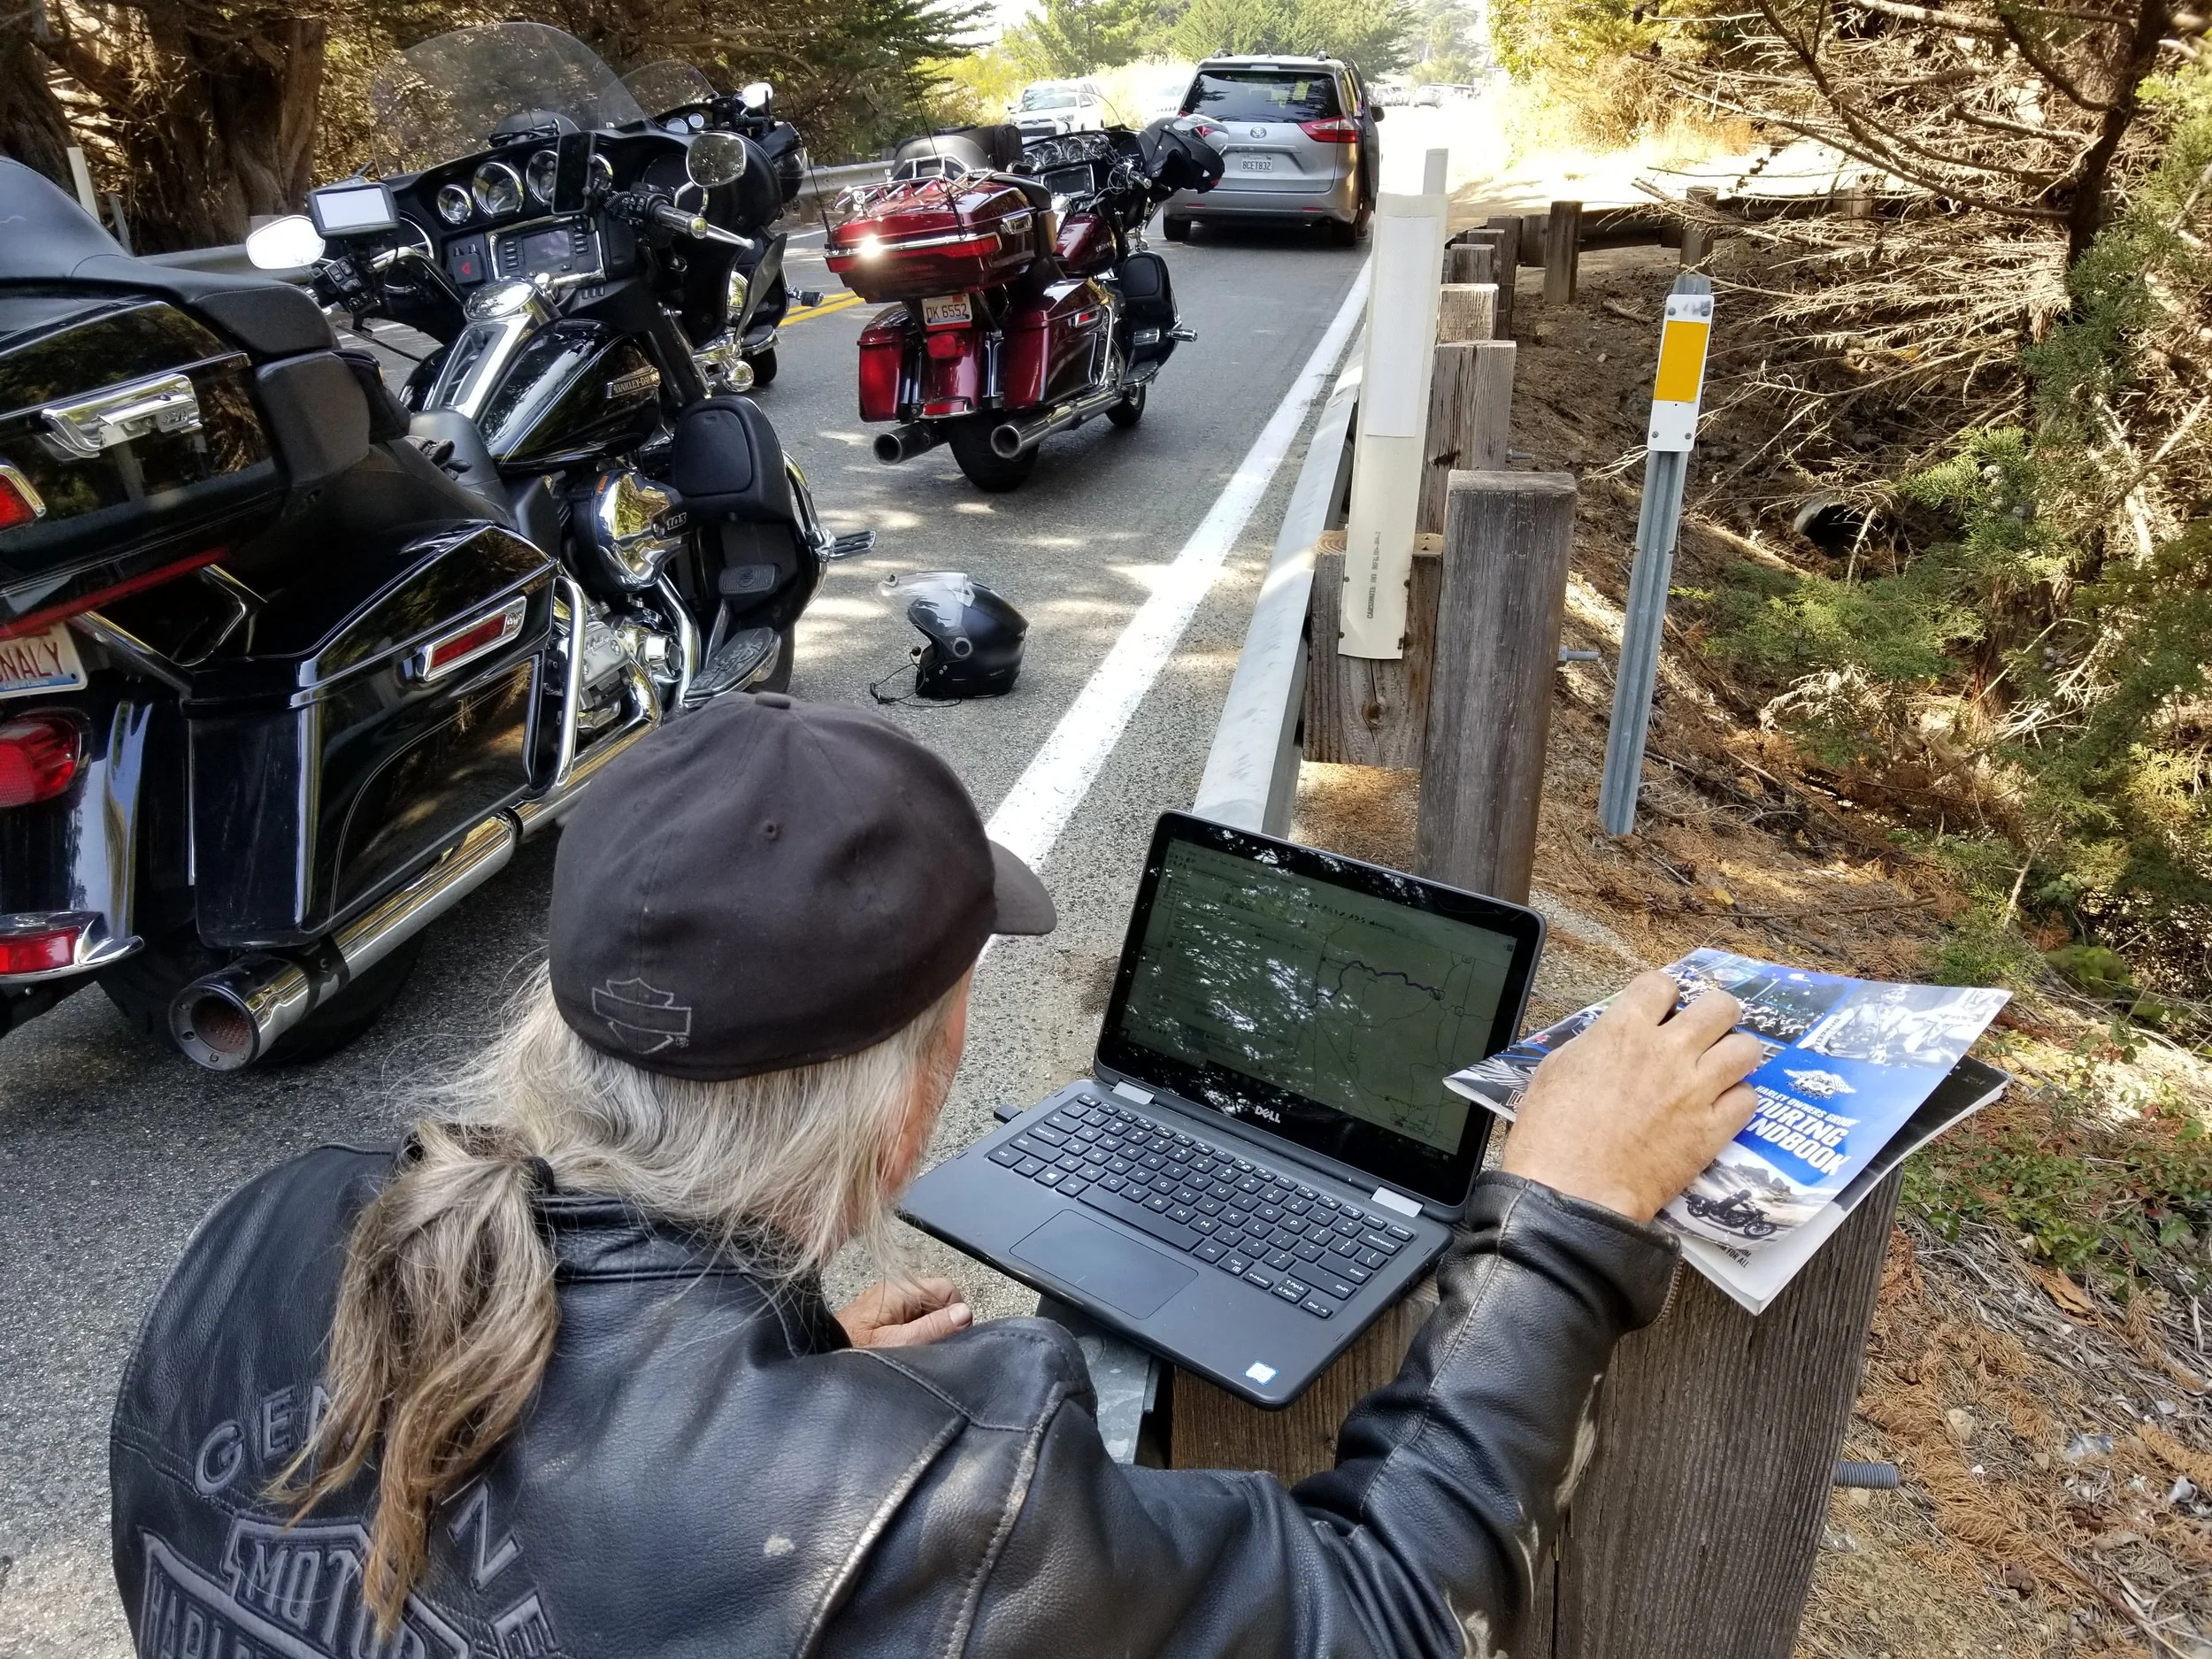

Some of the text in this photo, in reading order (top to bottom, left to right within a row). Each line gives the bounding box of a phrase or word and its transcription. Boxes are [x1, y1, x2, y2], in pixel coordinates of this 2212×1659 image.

[941, 303, 968, 319] 6552
[1755, 1086, 1790, 1102] HARLEY
[1787, 1097, 1827, 1118] OWNERS
[1255, 1105, 1281, 1124] DELL
[1755, 1095, 1849, 1148] OURING
[1746, 1116, 1852, 1176] NDBOOK
[1368, 1215, 1384, 1225] Insert
[1392, 1225, 1409, 1235] Delete
[1368, 1234, 1395, 1248] Backspace
[1726, 1248, 1740, 1261] FOR
[1349, 1268, 1365, 1277] Enter
[1335, 1284, 1348, 1293] Shift
